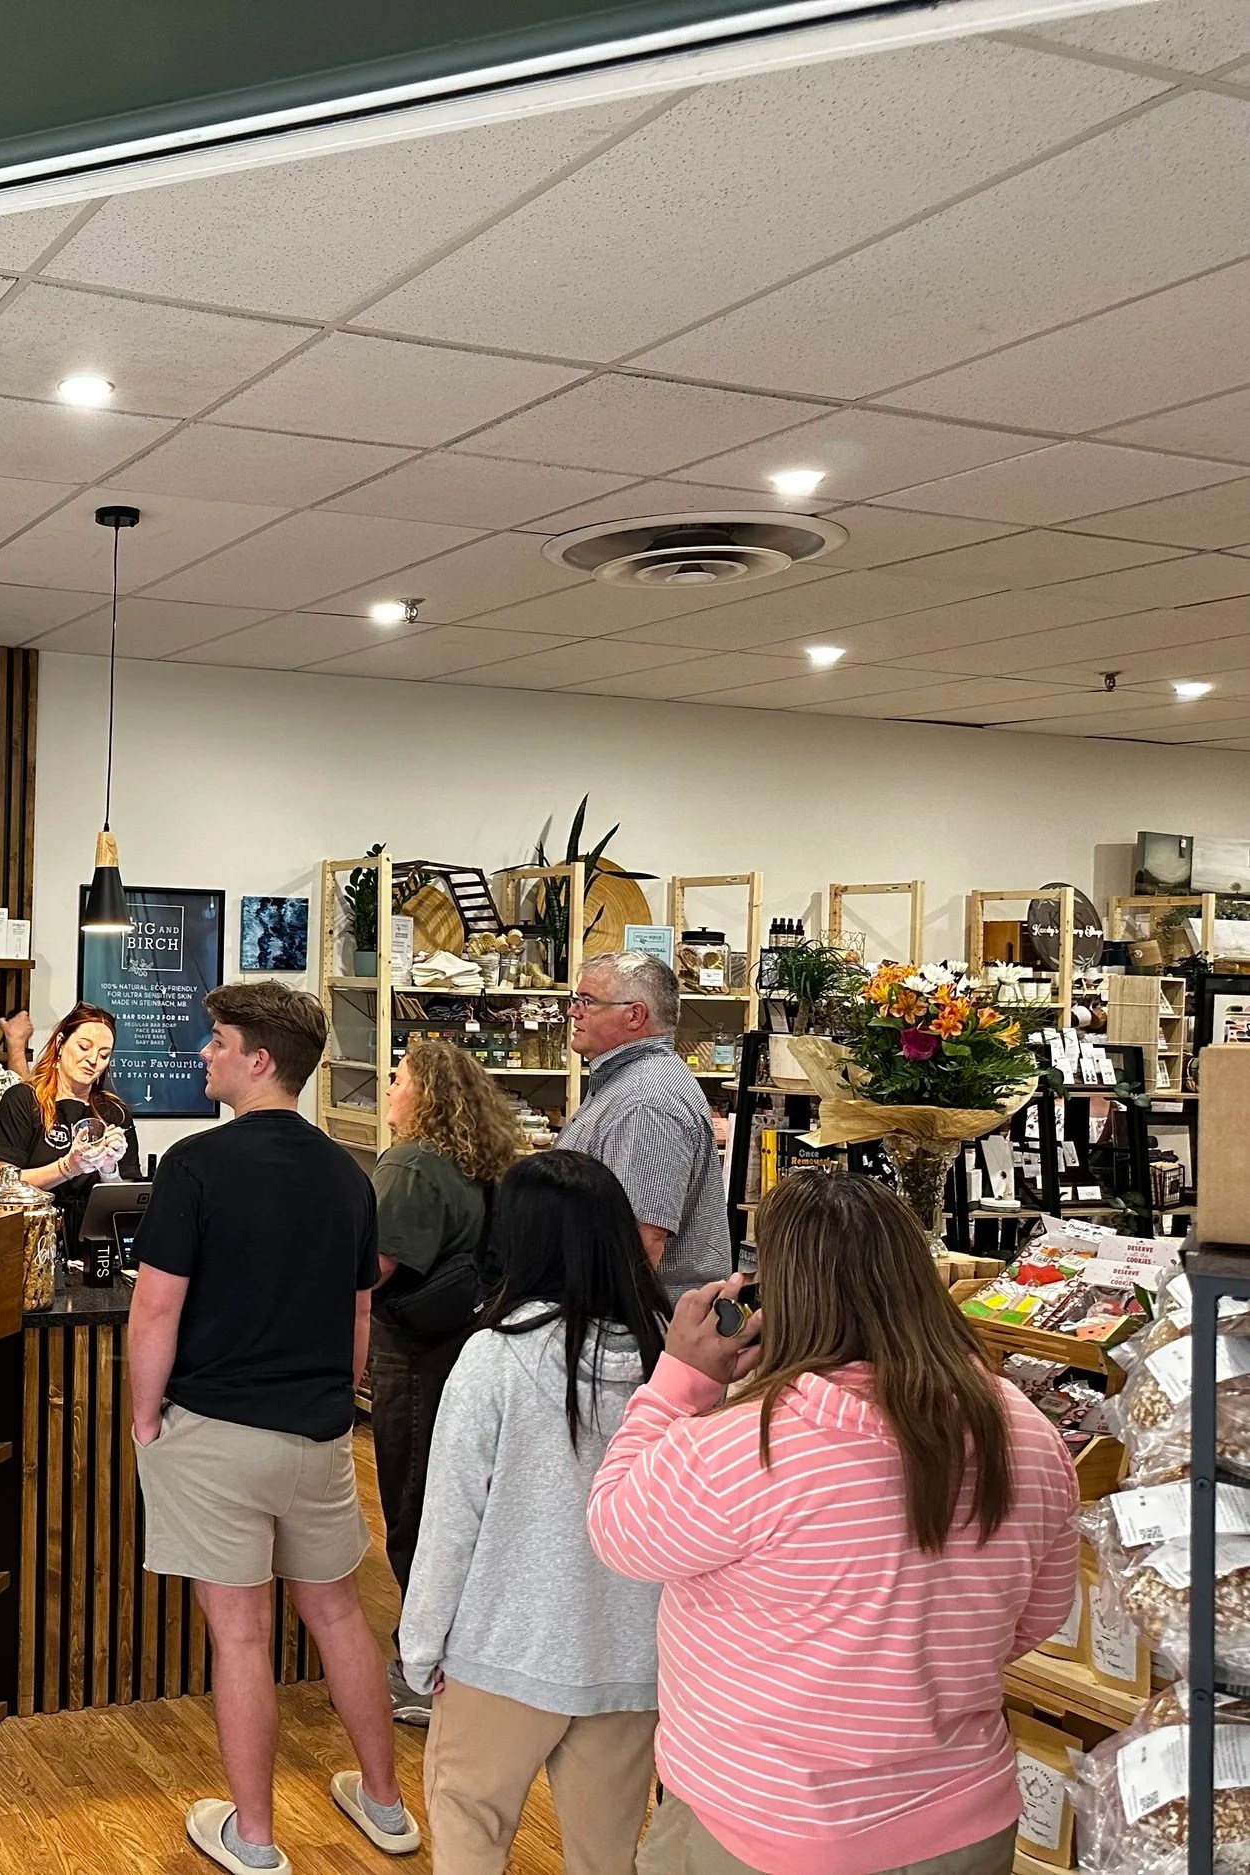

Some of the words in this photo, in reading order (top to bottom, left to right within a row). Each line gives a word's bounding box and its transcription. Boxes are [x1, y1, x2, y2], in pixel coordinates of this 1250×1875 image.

[159, 926, 179, 934] AND
[127, 937, 179, 951] BIRCH
[120, 1059, 146, 1068] Your
[150, 1059, 203, 1069] Favourite
[799, 1149, 819, 1157] Once
[1127, 1245, 1153, 1253] DESERVE
[97, 1246, 110, 1278] TIPS
